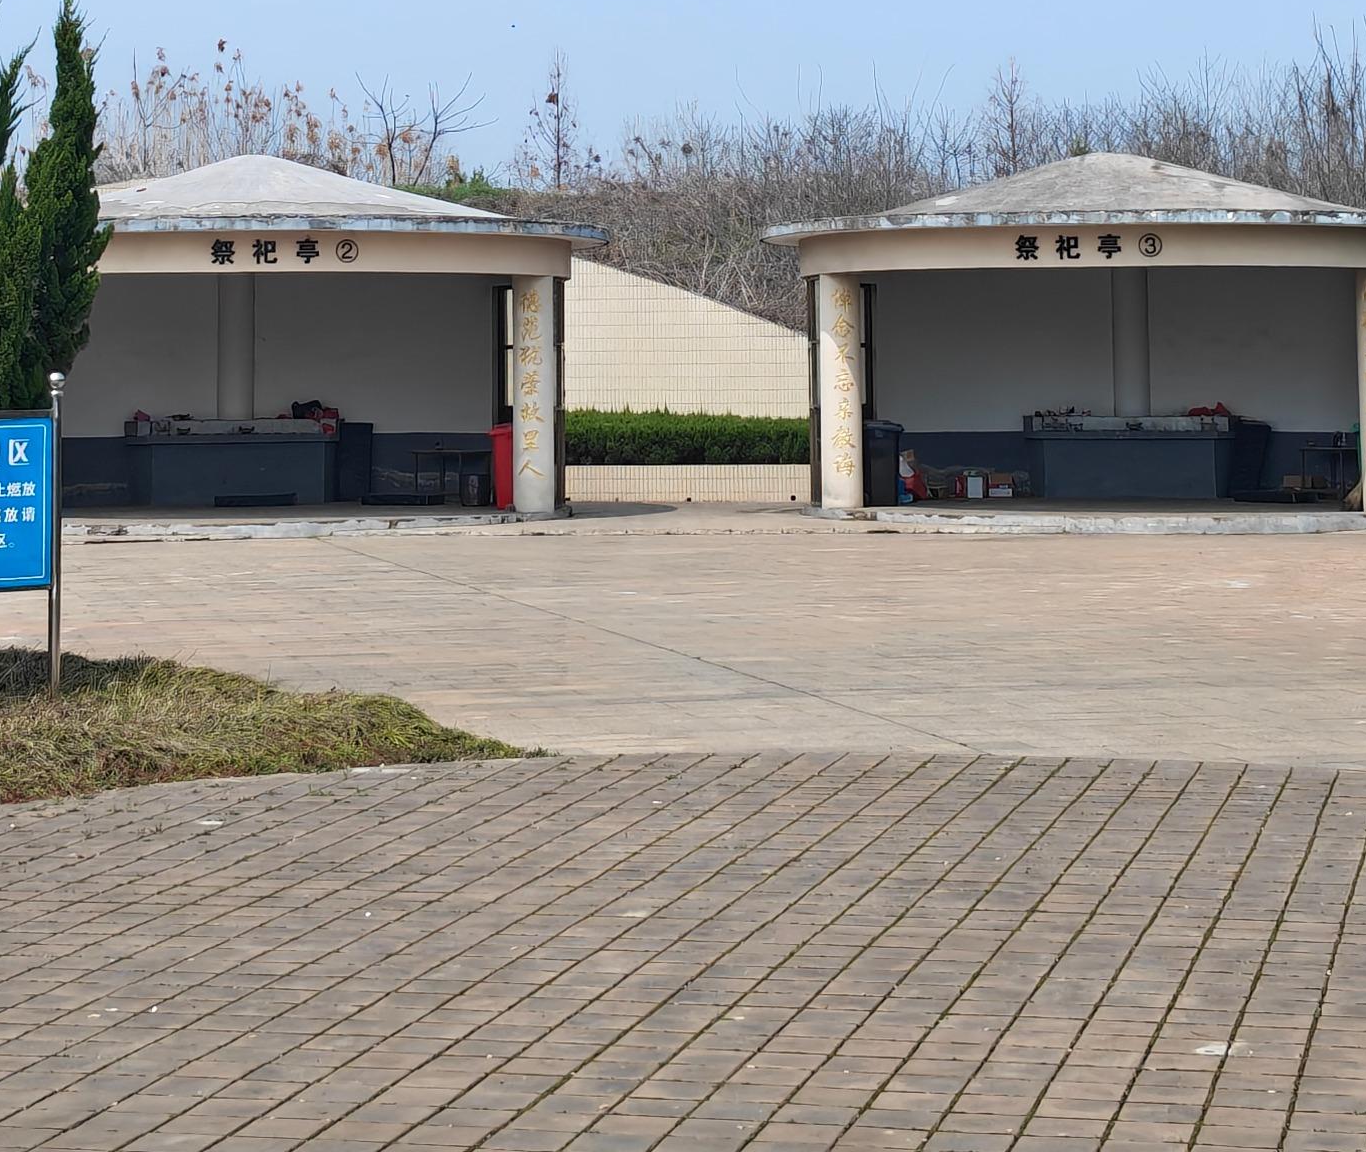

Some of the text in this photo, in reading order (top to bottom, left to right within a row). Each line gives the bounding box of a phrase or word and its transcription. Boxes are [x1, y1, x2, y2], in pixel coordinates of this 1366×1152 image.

[210, 235, 359, 264] 祭祀亭②
[1015, 233, 1162, 260] 祭祀亭③
